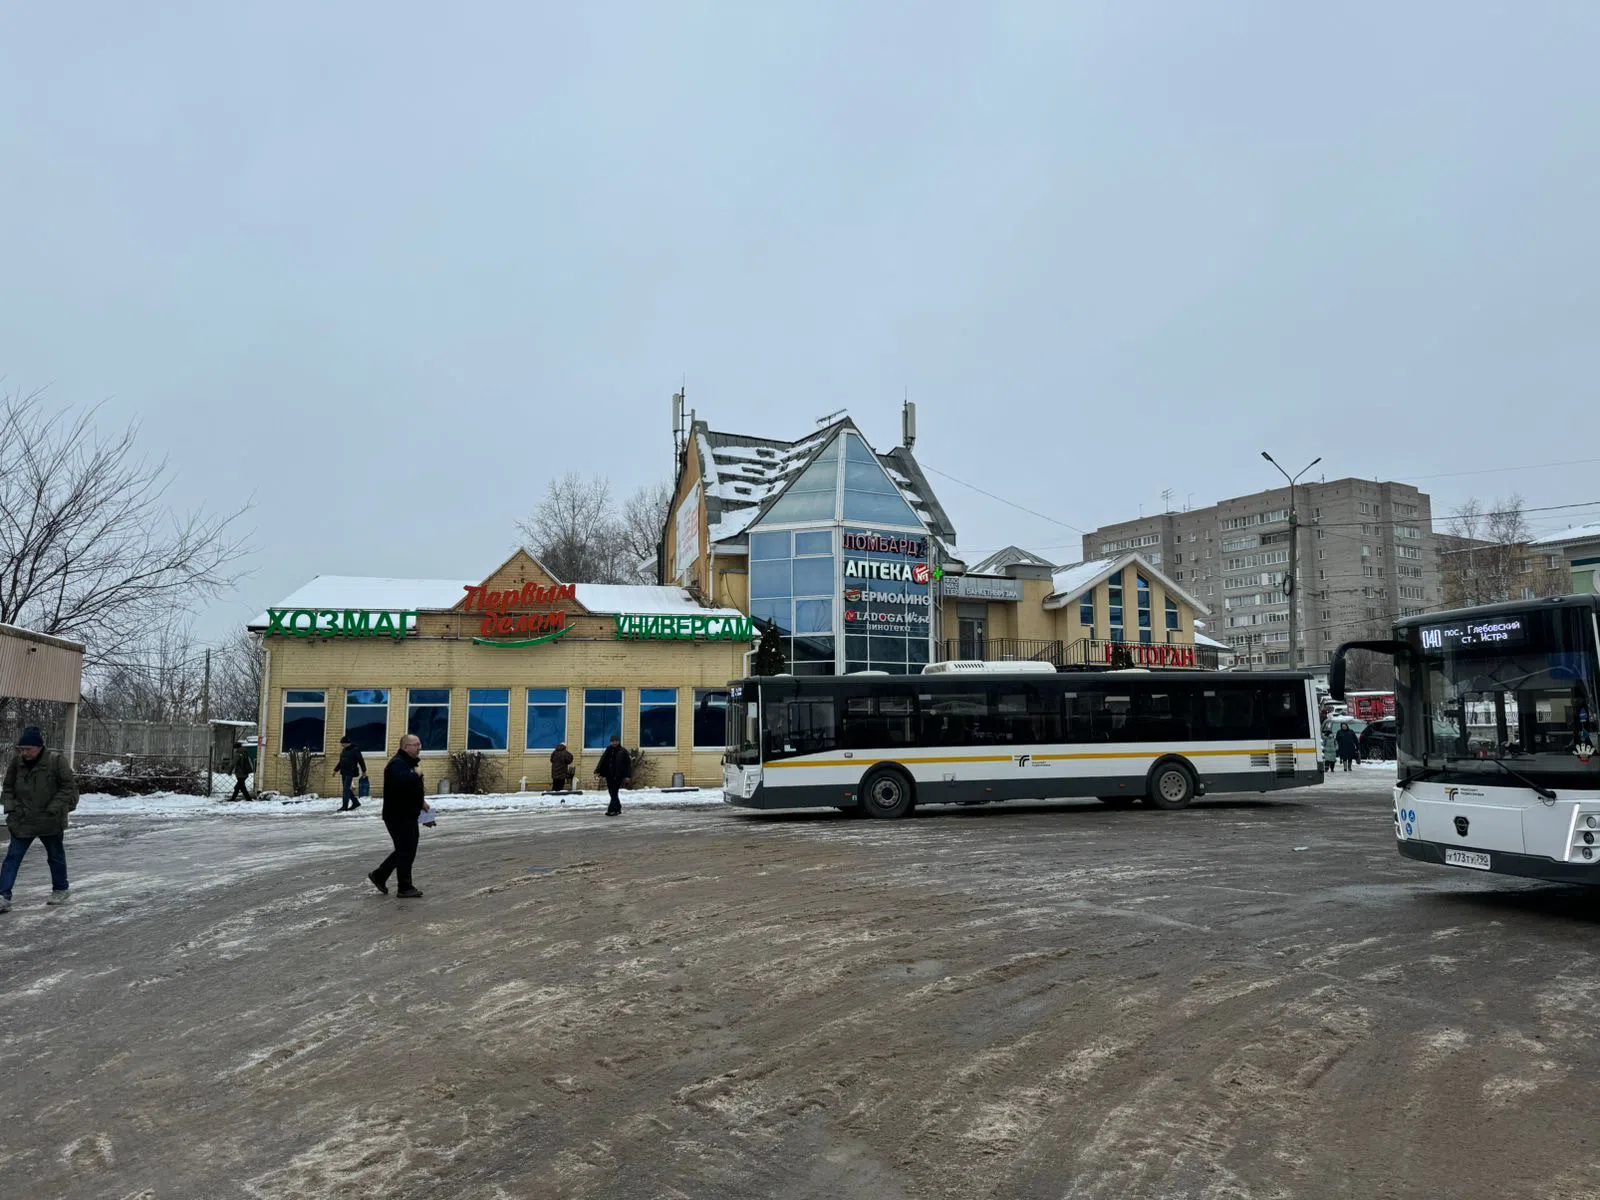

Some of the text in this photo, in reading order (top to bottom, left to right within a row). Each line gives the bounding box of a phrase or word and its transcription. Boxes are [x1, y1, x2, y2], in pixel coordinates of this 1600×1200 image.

[843, 534, 918, 555] ЛОМБАРД
[845, 560, 913, 581] АПТЕКА
[463, 582, 576, 614] Первым
[861, 591, 931, 606] ЕРМОЛИНО
[264, 608, 420, 639] ХОЗМАГ
[480, 610, 566, 637] делом
[613, 613, 754, 641] УНИВЕРСАМ
[1444, 621, 1520, 637] пос. Глебовский
[1422, 629, 1442, 648] 040
[1461, 633, 1508, 644] ст. Истра
